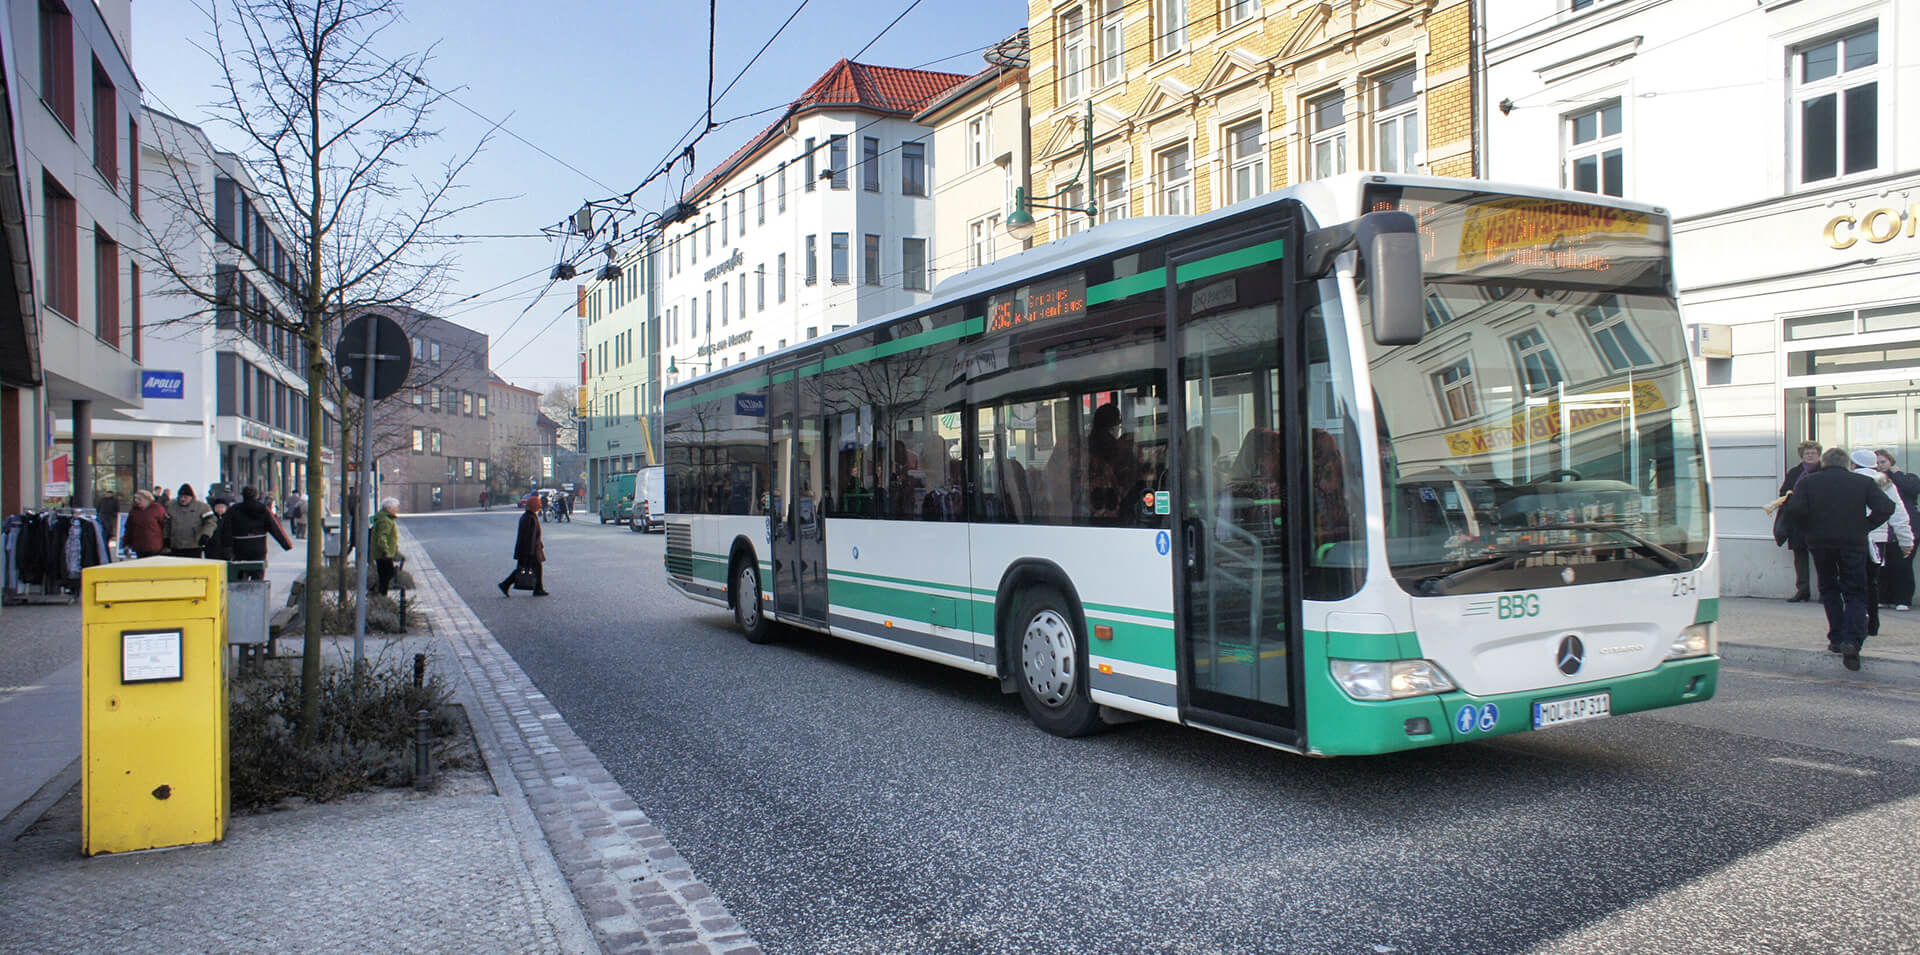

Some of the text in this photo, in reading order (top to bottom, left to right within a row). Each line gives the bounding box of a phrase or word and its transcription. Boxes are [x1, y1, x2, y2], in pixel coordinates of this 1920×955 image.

[1671, 576, 1697, 597] 254
[1497, 593, 1541, 620] BBG
[1542, 695, 1609, 723] MOL AP 311
